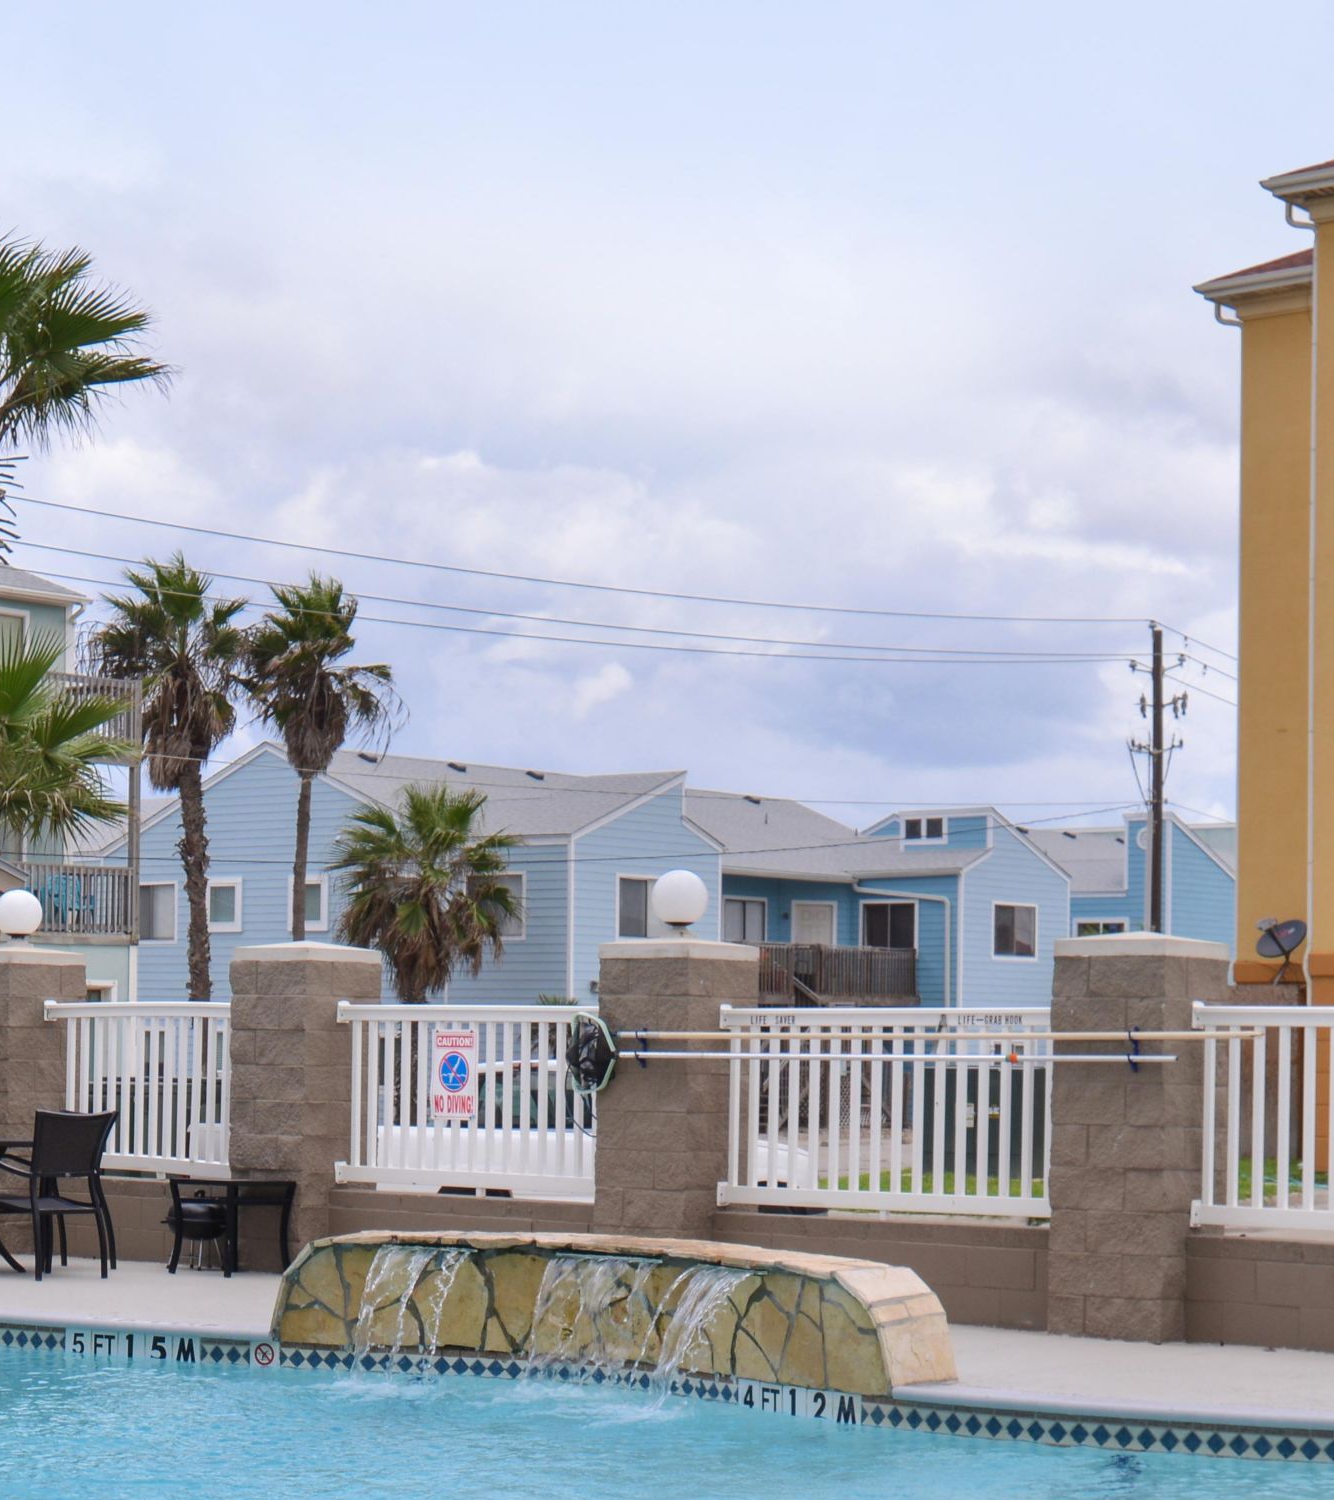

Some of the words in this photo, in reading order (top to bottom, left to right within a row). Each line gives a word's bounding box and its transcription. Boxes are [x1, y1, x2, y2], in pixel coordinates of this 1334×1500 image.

[750, 1015, 766, 1024] LIFE
[776, 1015, 795, 1024] SAVER
[1005, 1015, 1023, 1024] HOOK
[437, 1037, 473, 1047] CAUTION!
[434, 1095, 444, 1113] NO
[447, 1095, 474, 1113] DIVING!
[176, 1338, 195, 1362] M
[744, 1385, 754, 1408] 4
[837, 1395, 856, 1424] M
